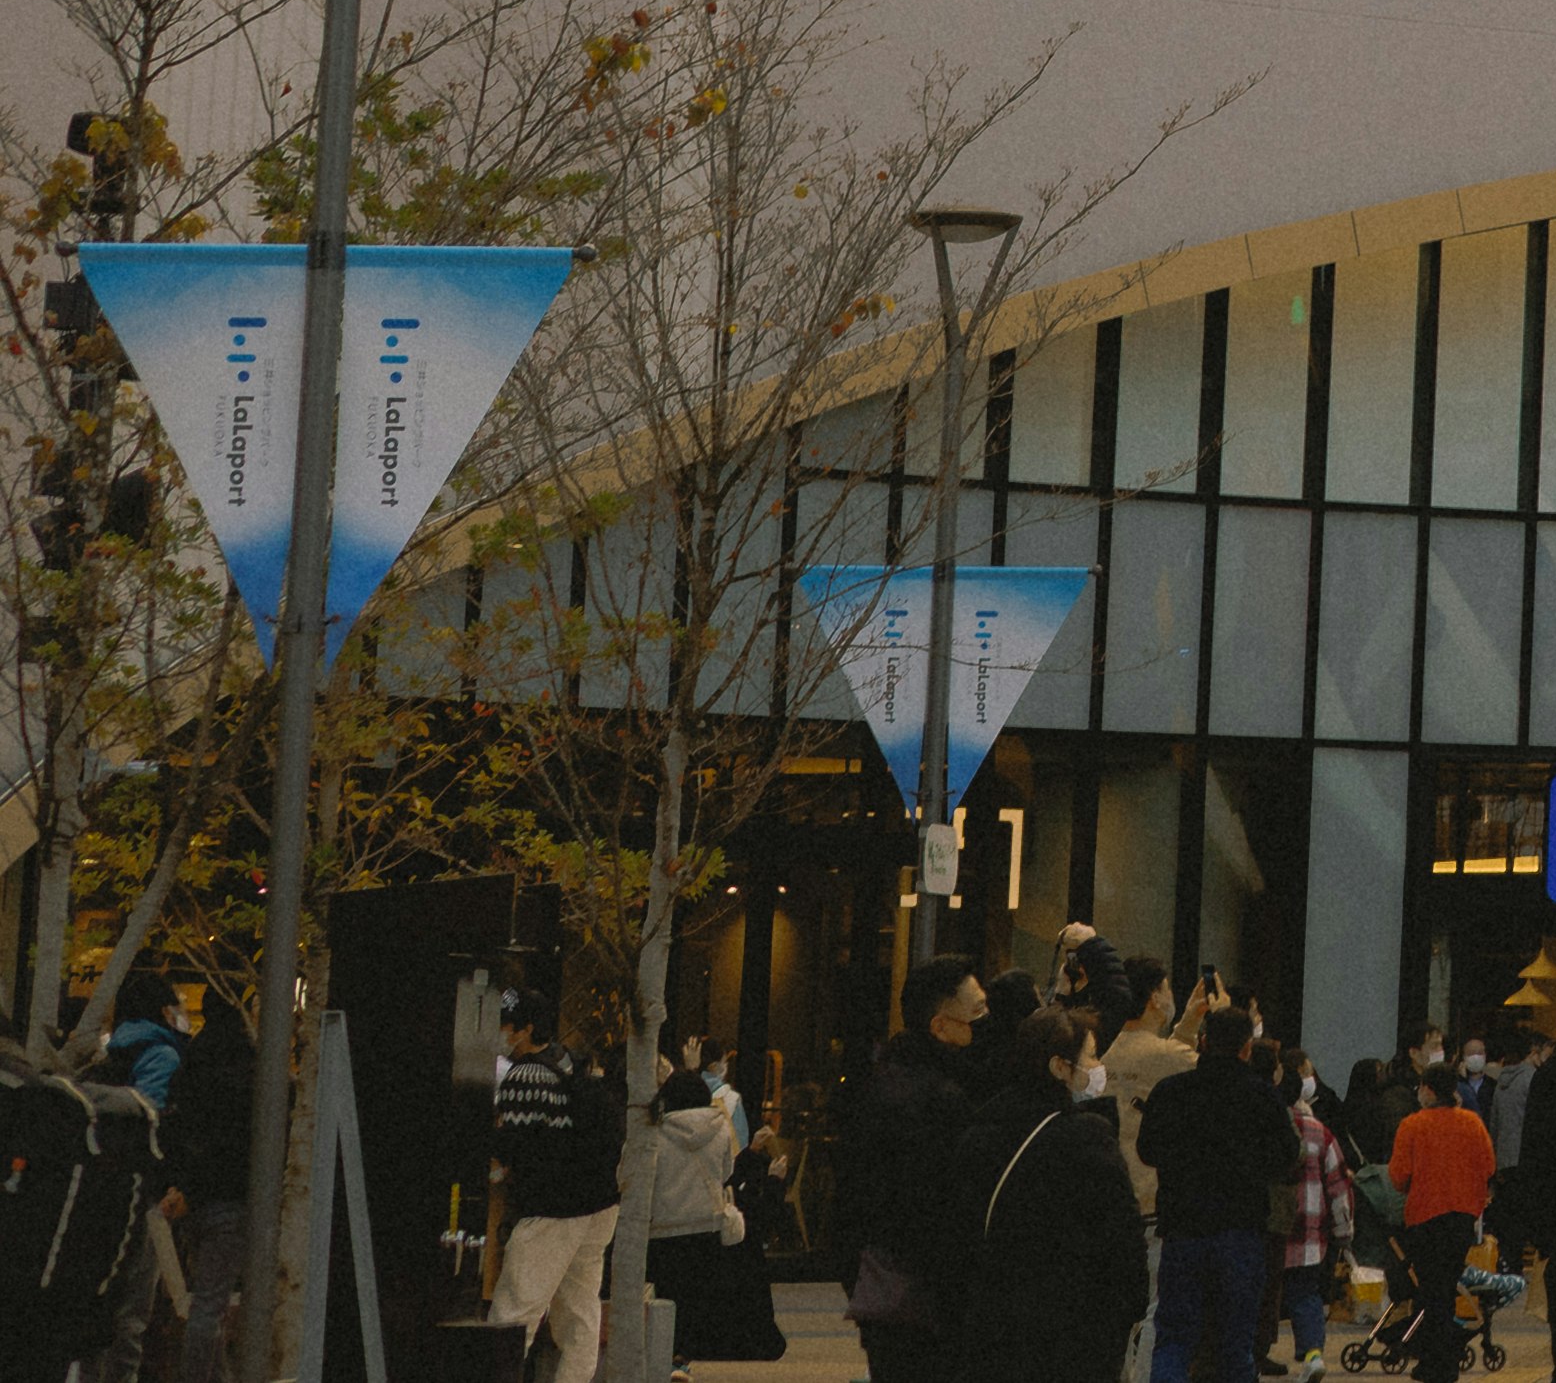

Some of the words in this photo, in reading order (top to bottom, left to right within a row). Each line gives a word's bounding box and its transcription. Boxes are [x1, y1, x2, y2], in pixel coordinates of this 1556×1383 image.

[226, 395, 255, 507] LaLaport
[378, 397, 407, 508] LaLaport
[884, 657, 900, 724] LaLaport
[975, 657, 991, 724] LaLaport
